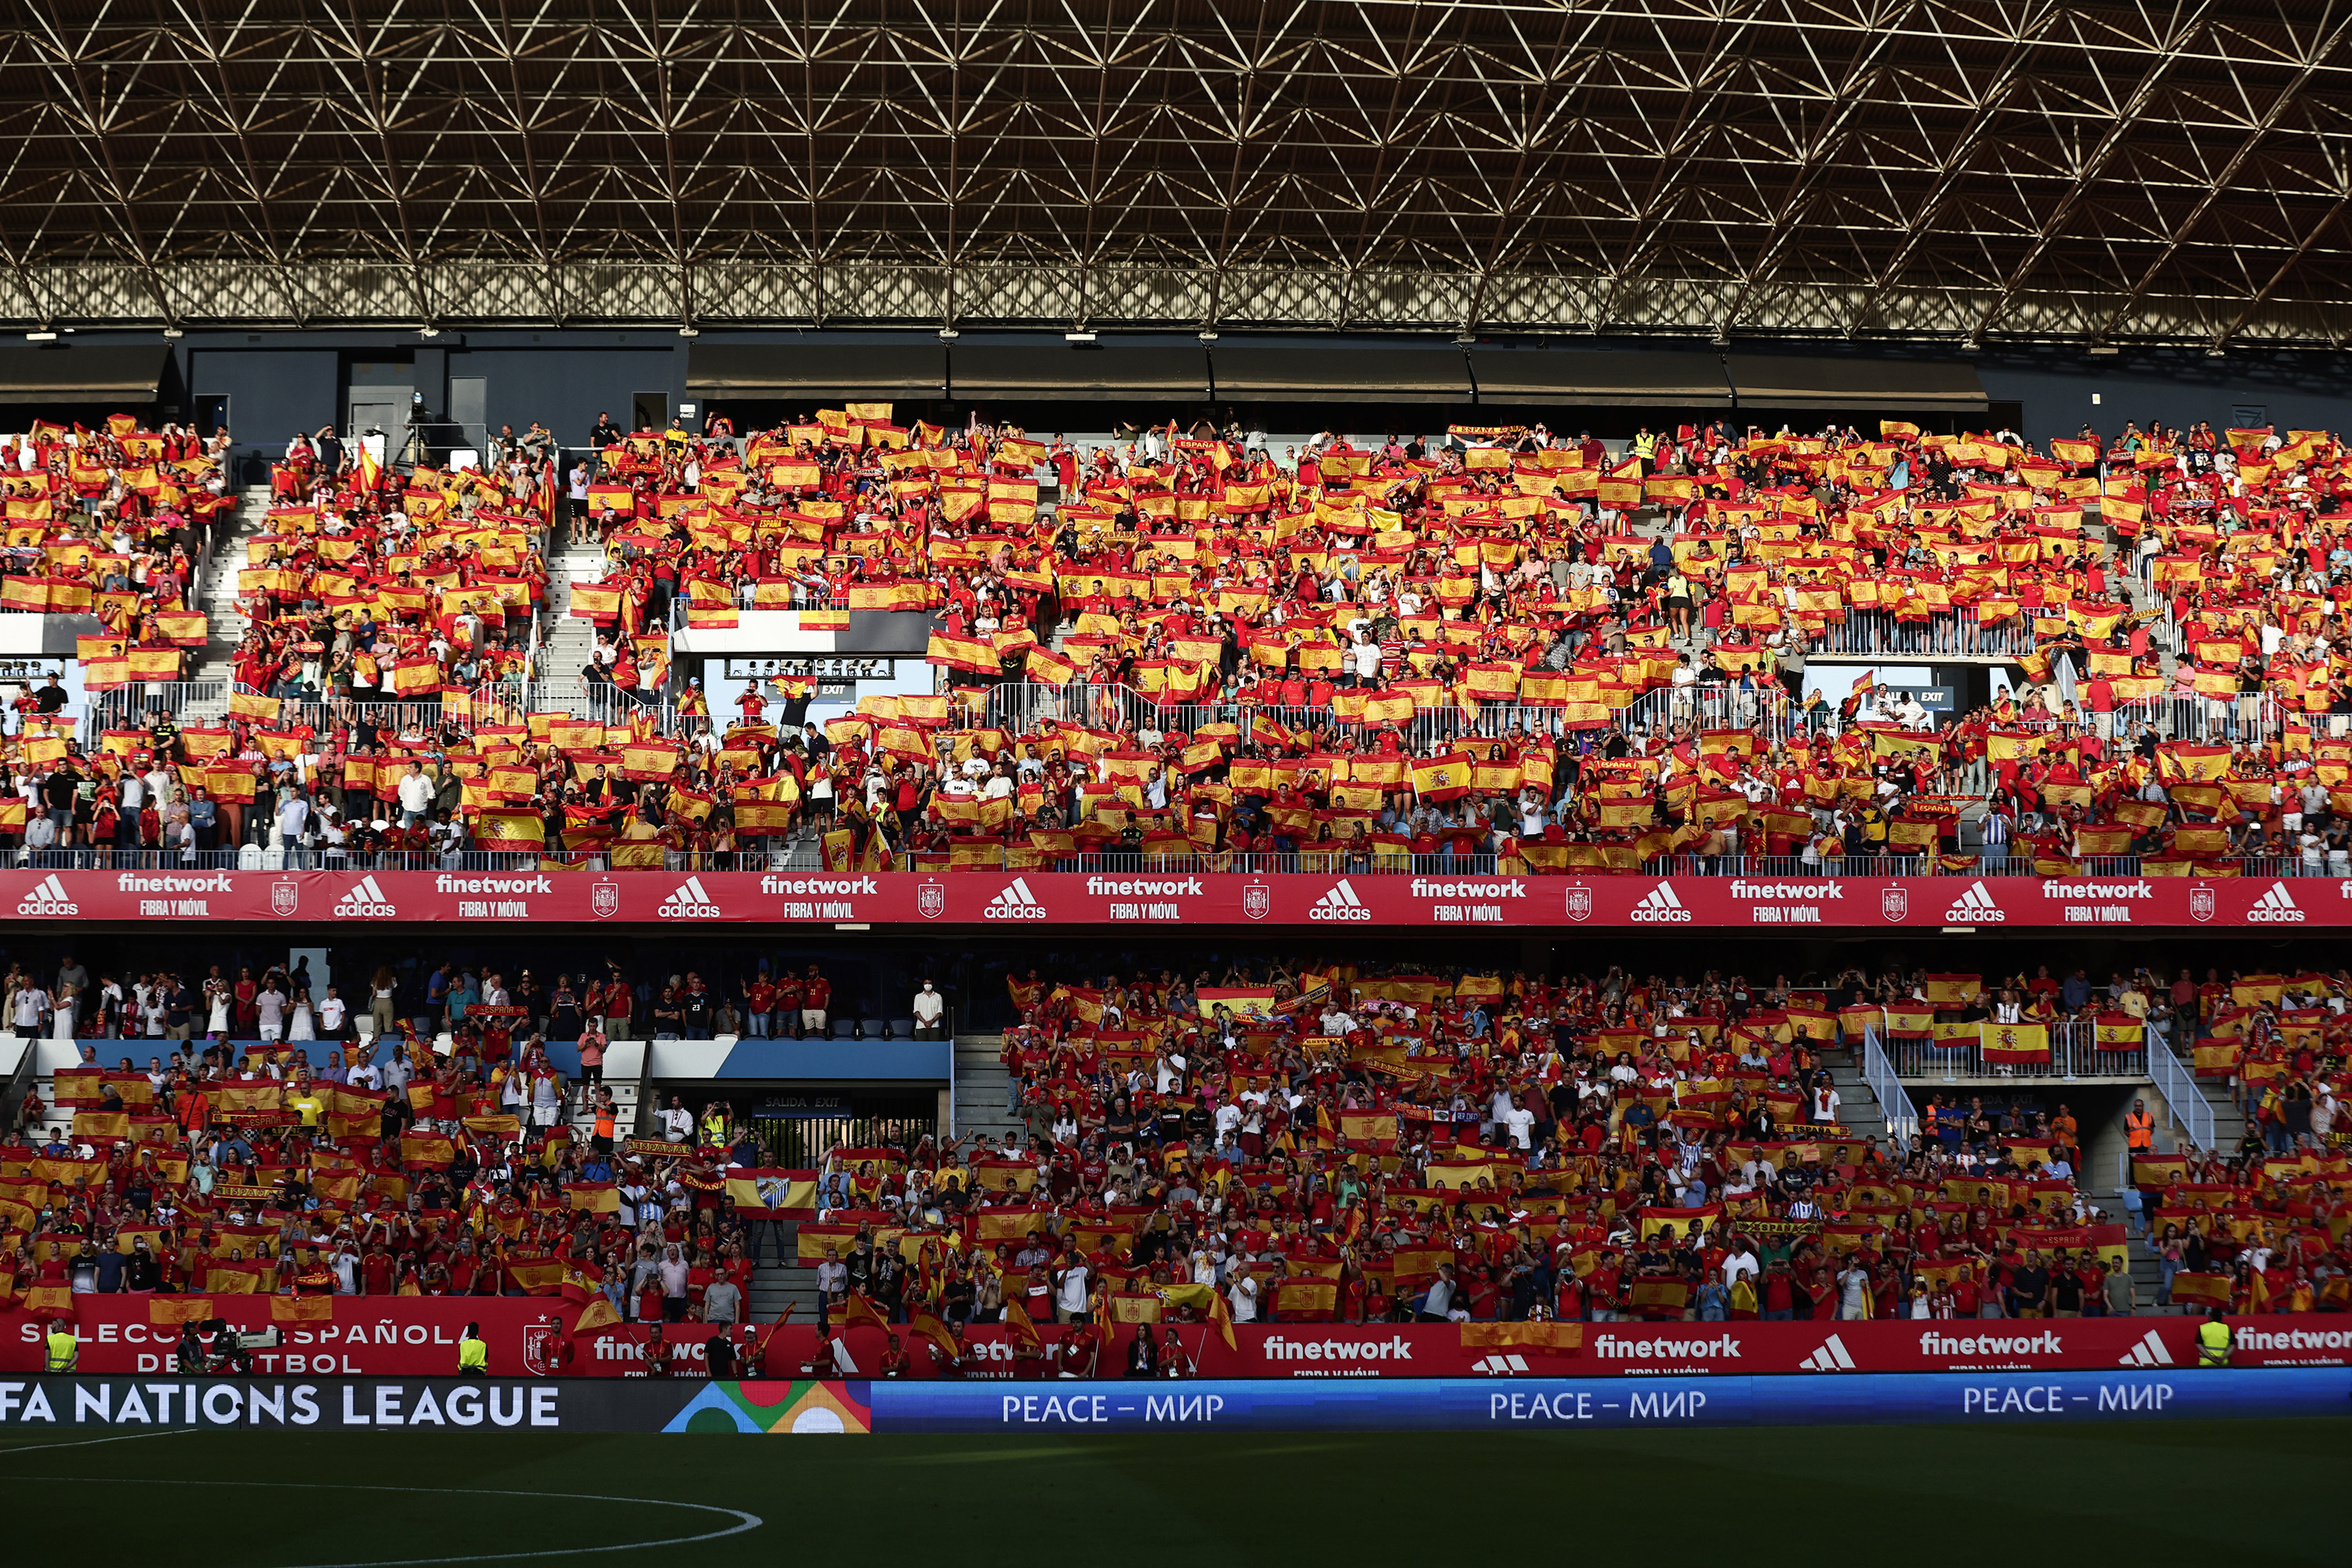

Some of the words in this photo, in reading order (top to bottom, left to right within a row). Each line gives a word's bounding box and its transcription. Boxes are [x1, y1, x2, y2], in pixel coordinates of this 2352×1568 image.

[1180, 440, 1214, 448] ESPAÑA
[759, 519, 782, 528] ESPAÑA
[822, 684, 846, 695] EXIT
[1920, 692, 1944, 701] EXIT
[1918, 803, 1950, 812] ESPAÑA
[118, 873, 233, 892] finetwork
[436, 873, 553, 893] finetwork
[760, 875, 877, 895] finetwork
[1087, 876, 1203, 895] finetwork
[1411, 878, 1526, 897] finetwork
[1730, 880, 1844, 898] finetwork
[2042, 880, 2153, 898] finetwork
[17, 901, 78, 915] adidas
[140, 900, 169, 916] FIBRA
[170, 900, 177, 916] Y
[179, 898, 209, 916] MÓVIL
[334, 902, 395, 916] adidas
[459, 902, 488, 916] FIBRA
[489, 902, 496, 916] Y
[497, 899, 528, 916] MÓVIL
[658, 902, 720, 917] adidas
[785, 902, 813, 918] FIBRA
[815, 902, 822, 918] Y
[823, 900, 854, 918] MÓVIL
[984, 904, 1046, 918] adidas
[1110, 904, 1138, 919] FIBRA
[1140, 904, 1148, 919] Y
[1149, 901, 1179, 919] MÓVIL
[1309, 906, 1370, 920] adidas
[1435, 906, 1463, 920] FIBRA
[1465, 906, 1472, 920] Y
[1472, 902, 1503, 920] MÓVIL
[1631, 907, 1691, 921] adidas
[1754, 907, 1781, 922] FIBRA
[1783, 907, 1790, 922] Y
[1791, 904, 1820, 922] MÓVIL
[1946, 907, 2005, 921] adidas
[2065, 906, 2092, 921] FIBRA
[2093, 906, 2100, 921] Y
[2101, 903, 2131, 921] MÓVIL
[2248, 907, 2304, 921] adidas
[484, 1005, 514, 1014] ESPAÑA
[1375, 1060, 1422, 1079] ESPAÑA
[765, 1097, 808, 1107] SALIDA
[815, 1097, 840, 1107] EXIT
[2011, 1094, 2034, 1104] EXIT
[249, 1116, 281, 1127] ESPAÑA
[1792, 1124, 1831, 1134] ESPAÑA
[636, 1143, 681, 1153] ESPAÑA
[684, 1174, 726, 1190] ESPAÑA
[226, 1186, 274, 1196] ESPAÑA
[1755, 1222, 1798, 1232] ESPAÑA
[1263, 1335, 1413, 1360] finetwork
[1594, 1334, 1742, 1358] finetwork
[1919, 1330, 2063, 1356] finetwork
[75, 1383, 320, 1425] NATIONS
[343, 1386, 559, 1427] LEAGUE
[1491, 1392, 1593, 1420] PEACE
[1629, 1392, 1706, 1418] МИР
[1965, 1386, 2063, 1413] PEACE
[2099, 1385, 2172, 1410] МИР
[1003, 1396, 1108, 1422] PEACE
[1145, 1395, 1224, 1421] МИР
